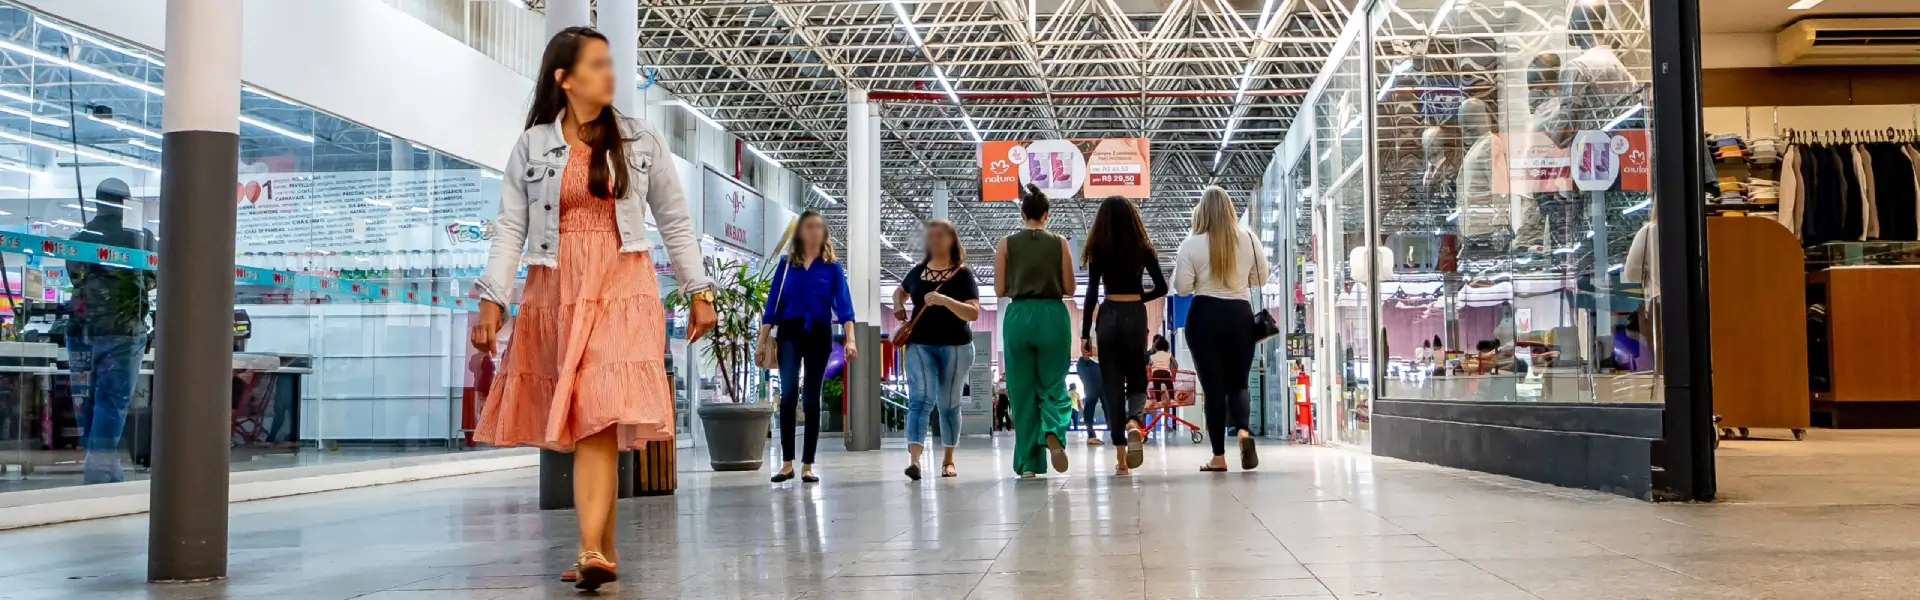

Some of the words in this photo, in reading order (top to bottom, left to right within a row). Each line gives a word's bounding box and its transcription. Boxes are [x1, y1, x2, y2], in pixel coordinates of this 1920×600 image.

[985, 176, 1015, 184] natura
[1102, 174, 1112, 182] R$
[1113, 175, 1135, 183] 29,50
